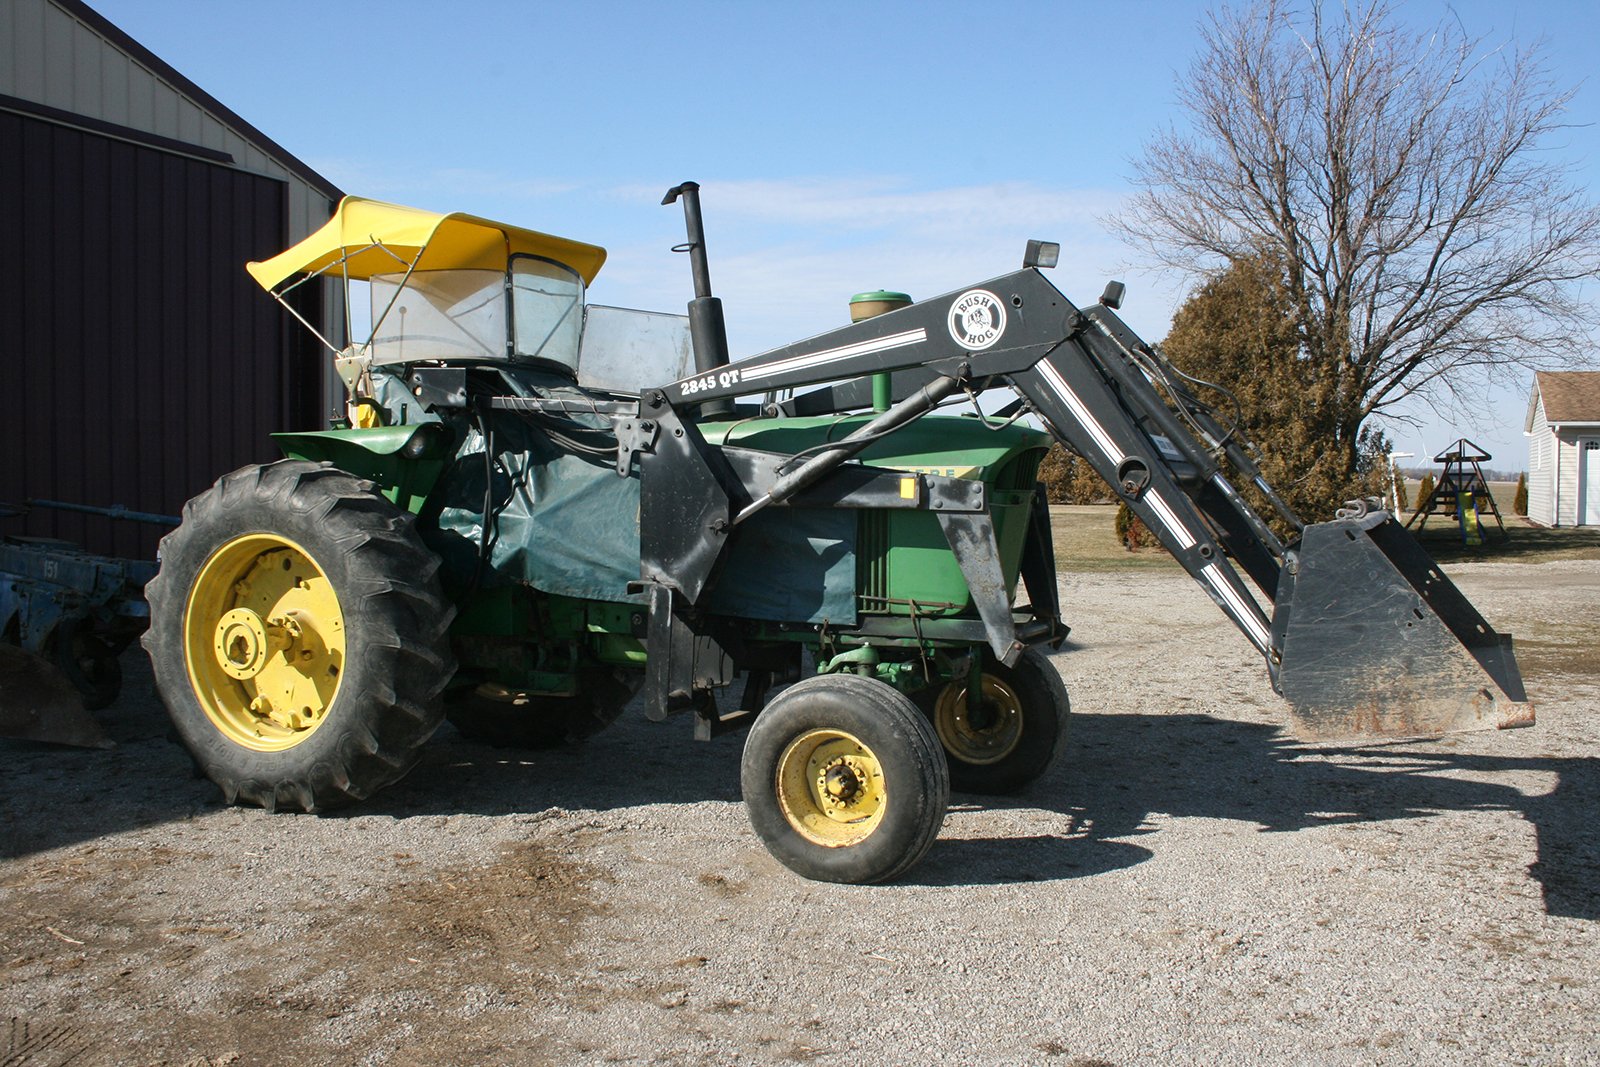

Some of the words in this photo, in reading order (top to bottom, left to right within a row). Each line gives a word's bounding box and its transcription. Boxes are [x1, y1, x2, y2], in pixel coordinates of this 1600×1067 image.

[958, 296, 990, 313] BUSH
[967, 330, 994, 344] HOG
[680, 375, 717, 396] 2845
[719, 369, 739, 388] QT
